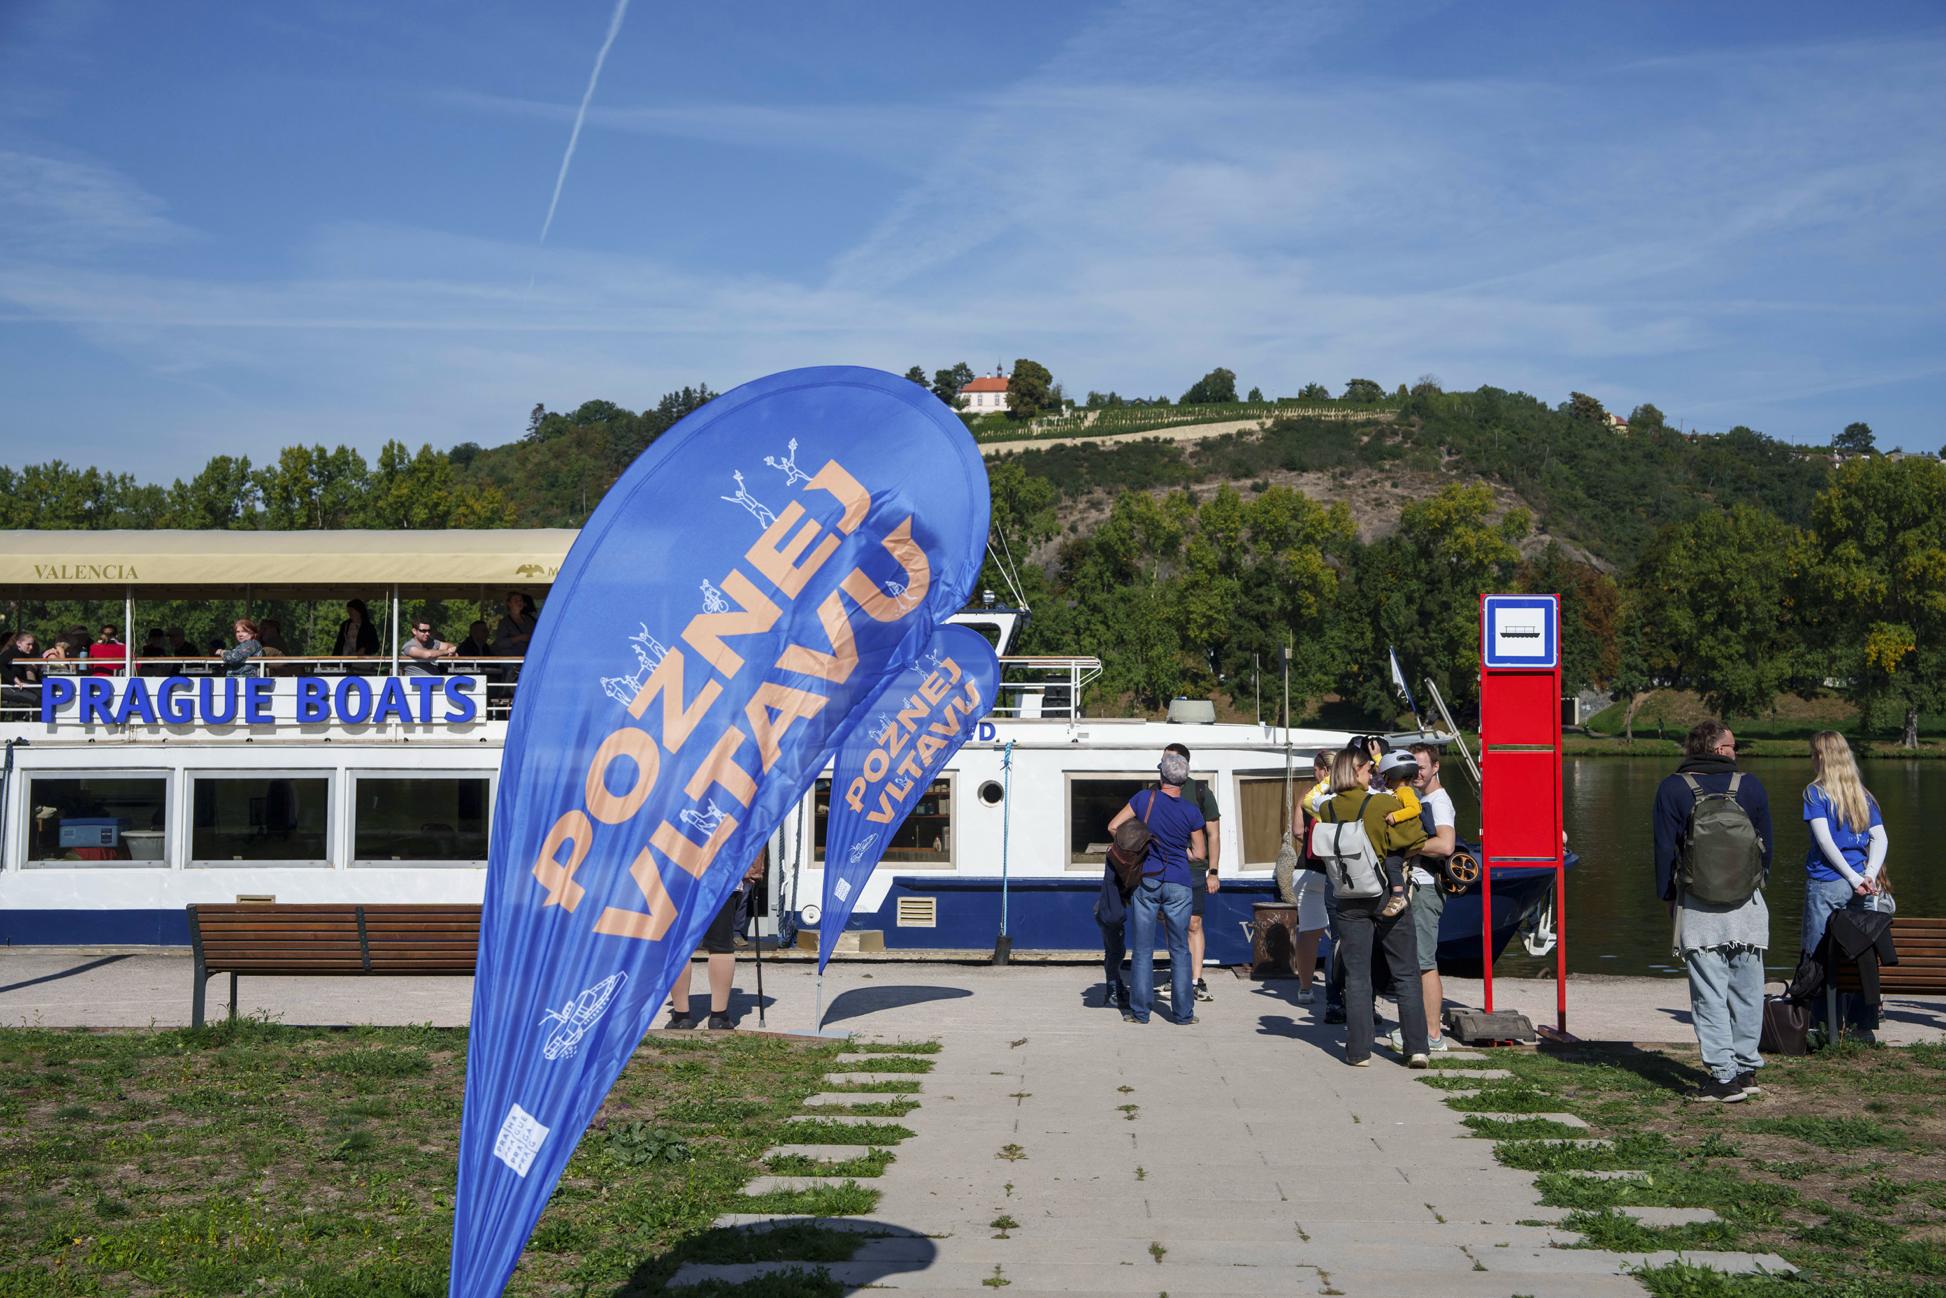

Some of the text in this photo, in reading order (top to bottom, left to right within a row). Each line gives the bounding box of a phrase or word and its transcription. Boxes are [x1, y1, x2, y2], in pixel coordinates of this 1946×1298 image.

[34, 564, 139, 580] VALENCIA
[41, 675, 477, 725] PRAGUE BOATS
[531, 459, 871, 913] POZNEJ
[592, 514, 931, 941] VLTAVU
[845, 656, 961, 814] POZNEJ
[866, 678, 981, 824] VLTAVU
